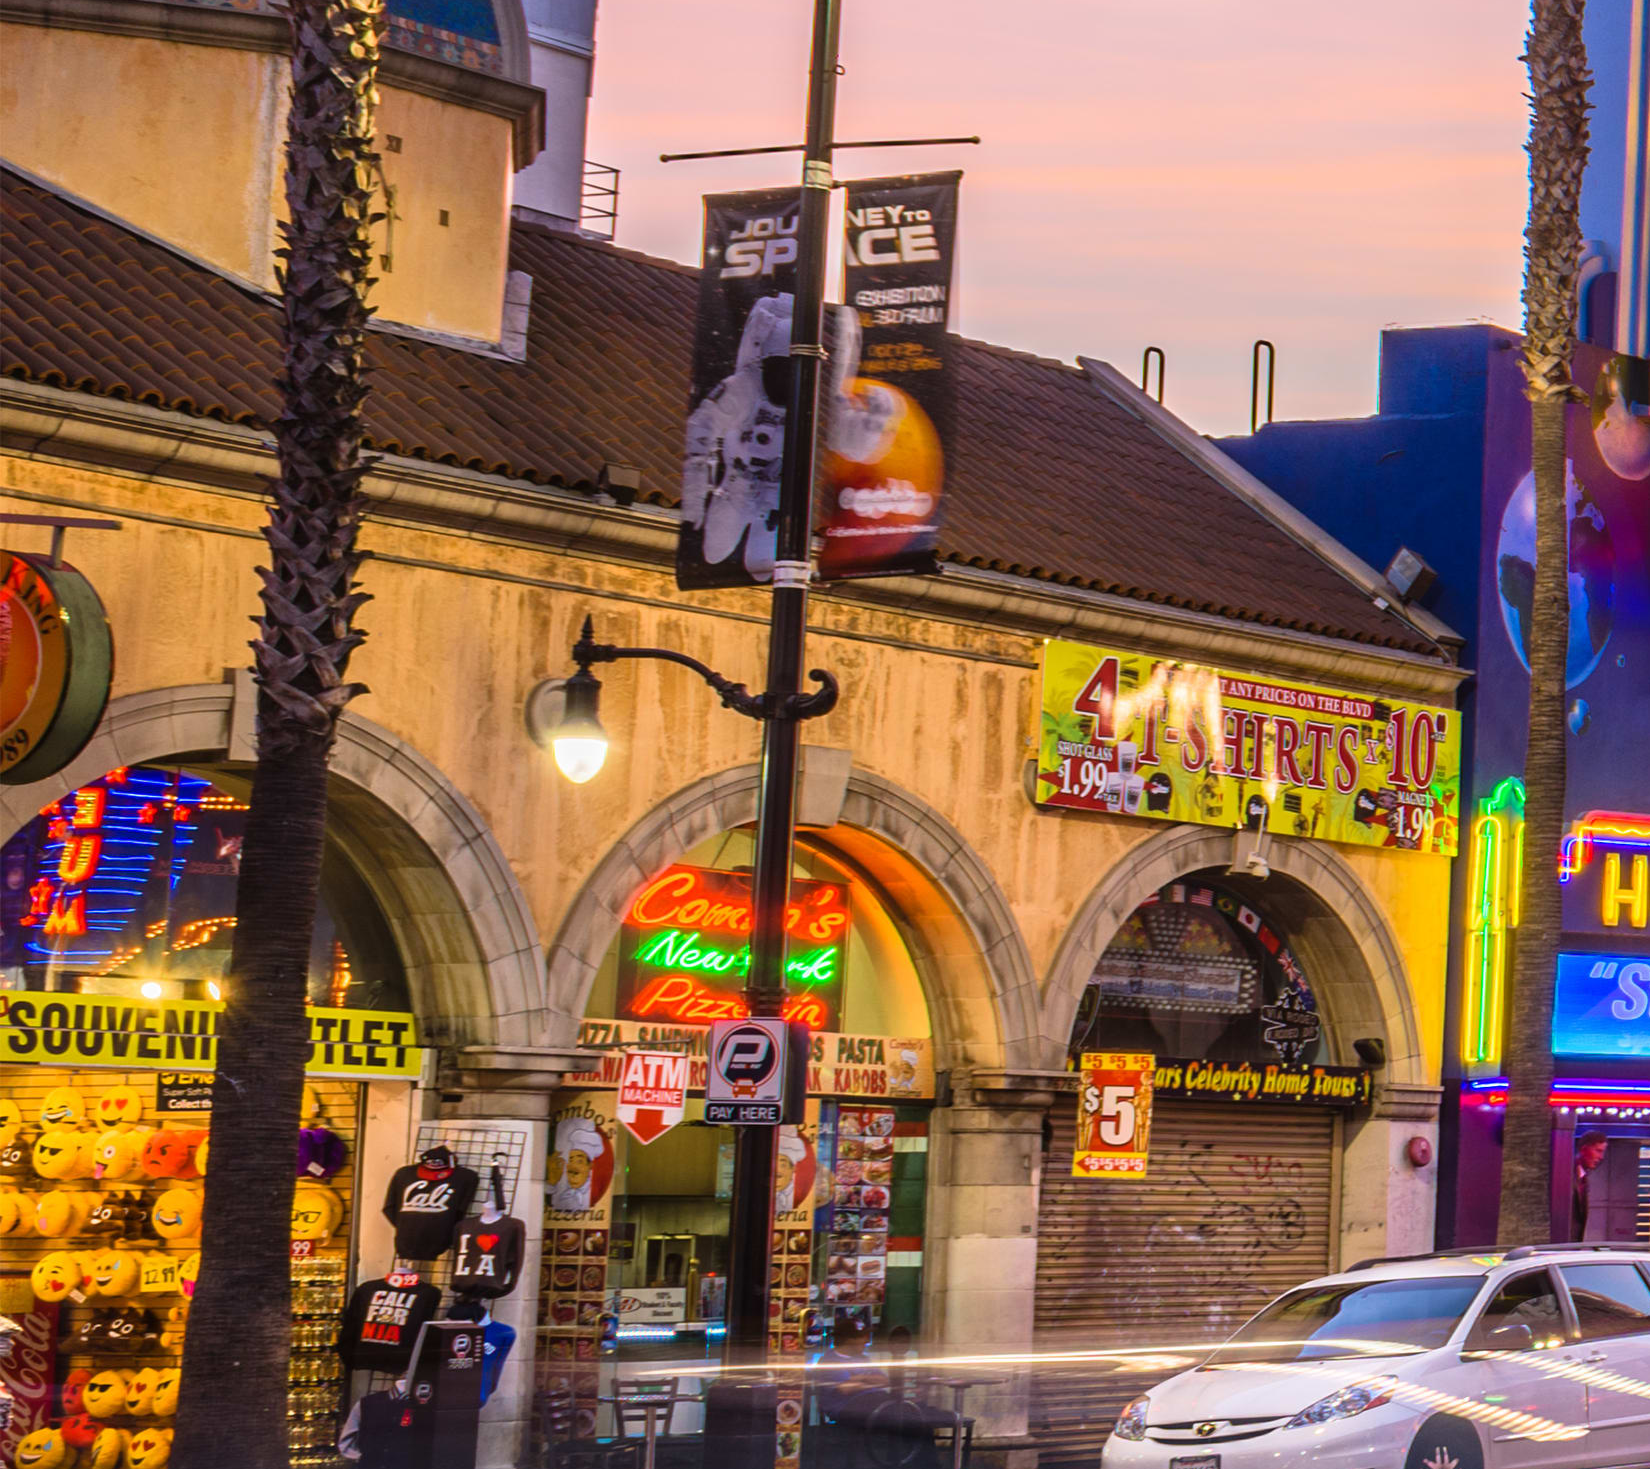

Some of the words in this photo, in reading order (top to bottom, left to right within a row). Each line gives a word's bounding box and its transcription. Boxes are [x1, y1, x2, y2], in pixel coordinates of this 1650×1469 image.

[730, 205, 904, 239] JOUNEY
[904, 209, 931, 222] TO
[720, 223, 940, 279] SPCE
[1229, 680, 1254, 701] ANY
[1255, 682, 1297, 706] PRICES
[1298, 690, 1317, 707] ON
[1317, 694, 1341, 713] THE
[1341, 697, 1373, 719] BLVD
[1072, 656, 1121, 740] 4
[1136, 695, 1361, 795] T-SHIRTS
[1057, 740, 1083, 760] SHOT
[1084, 746, 1114, 762] GLASS
[633, 872, 848, 940] Com's
[643, 929, 736, 973] New
[640, 977, 823, 1027] Pizzeia
[8, 999, 218, 1062] SOUVENI
[837, 1036, 885, 1066] PASTA
[624, 1055, 687, 1089] ATM
[833, 1068, 888, 1094] KABOBS
[1184, 1061, 1262, 1098] Celebrity
[1262, 1064, 1310, 1094] Home
[1312, 1068, 1357, 1097] Tours
[622, 1090, 682, 1105] MACHINE
[709, 1106, 735, 1120] PAY
[739, 1106, 777, 1121] HERE
[1084, 1085, 1137, 1146] $5
[401, 1179, 455, 1213] Cali
[459, 1233, 470, 1254] I
[370, 1290, 418, 1309] CALI
[360, 1321, 401, 1343] NIA
